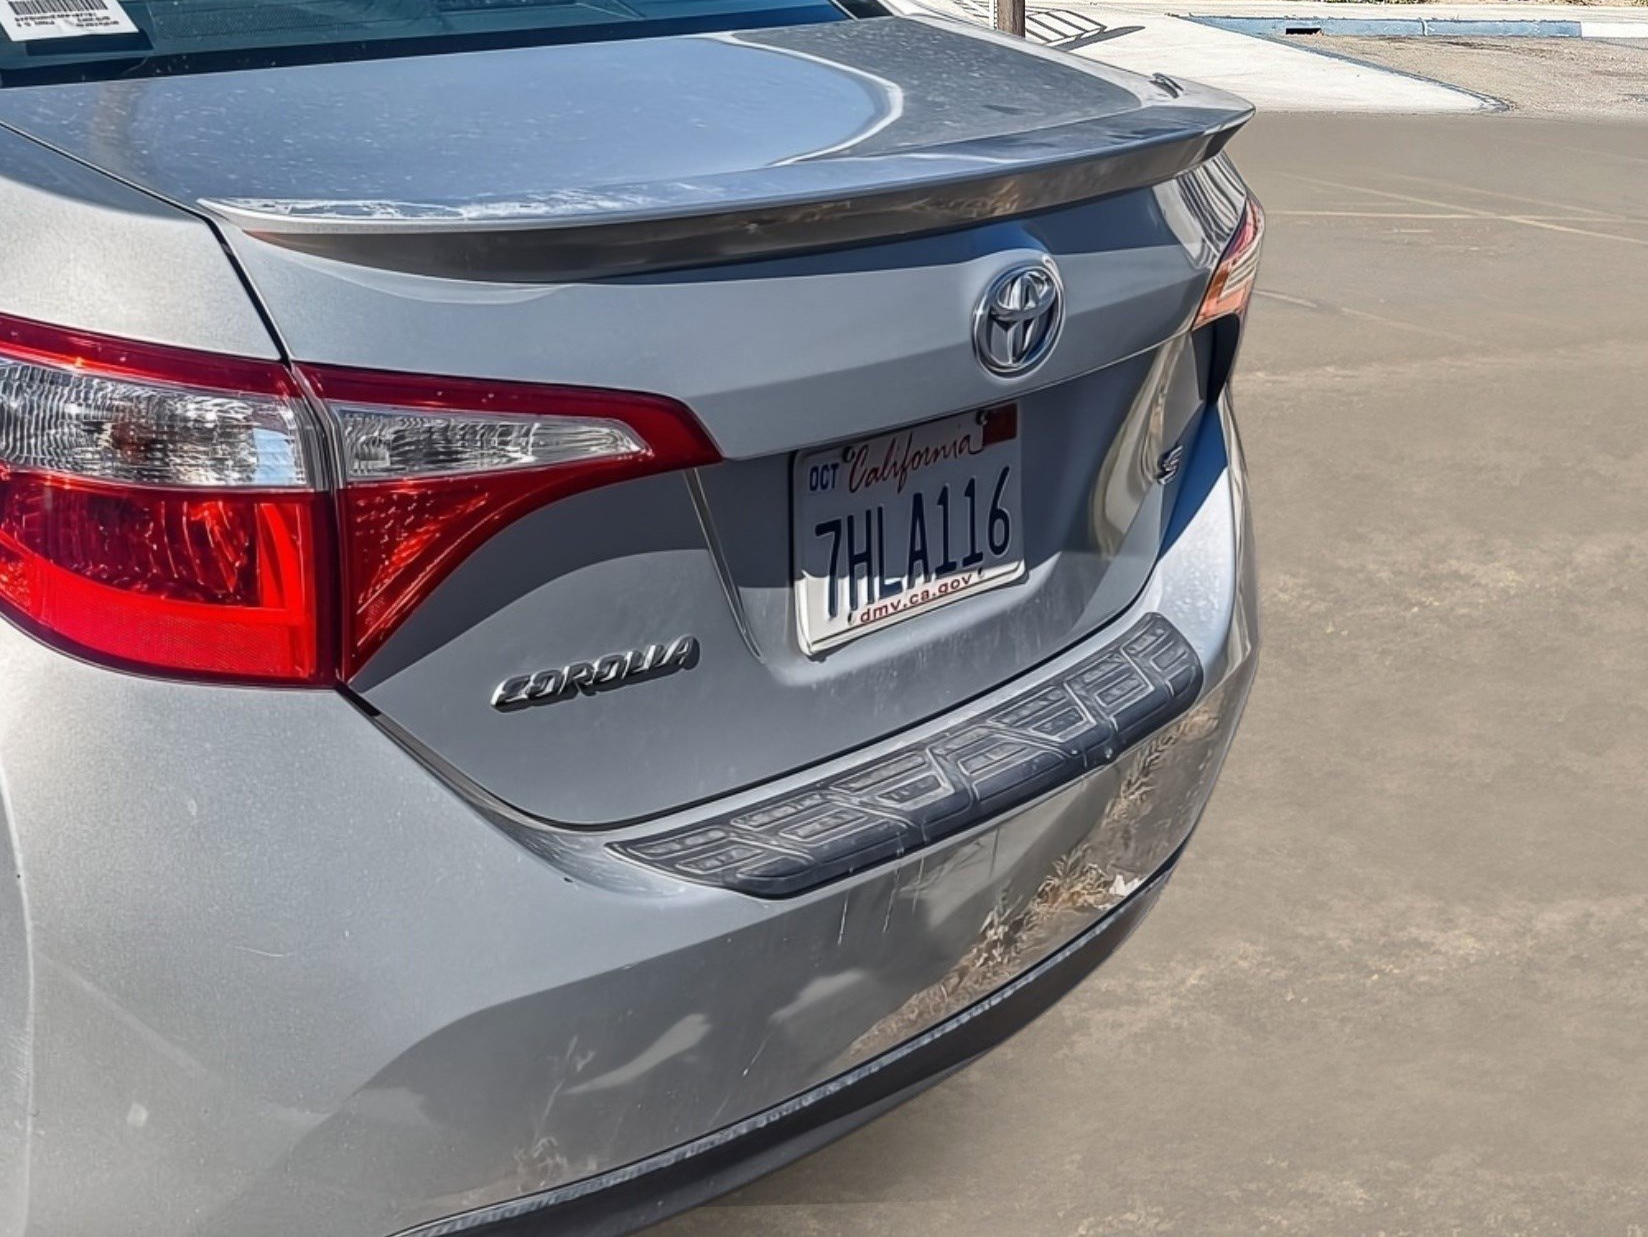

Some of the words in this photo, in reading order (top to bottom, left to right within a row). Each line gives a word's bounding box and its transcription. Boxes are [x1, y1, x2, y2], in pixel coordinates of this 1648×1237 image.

[809, 463, 840, 492] OCT
[847, 430, 985, 494] California
[814, 465, 1011, 621] 7HLA116
[859, 572, 973, 625] dmv.ca.gov
[490, 633, 701, 713] COROLLA
